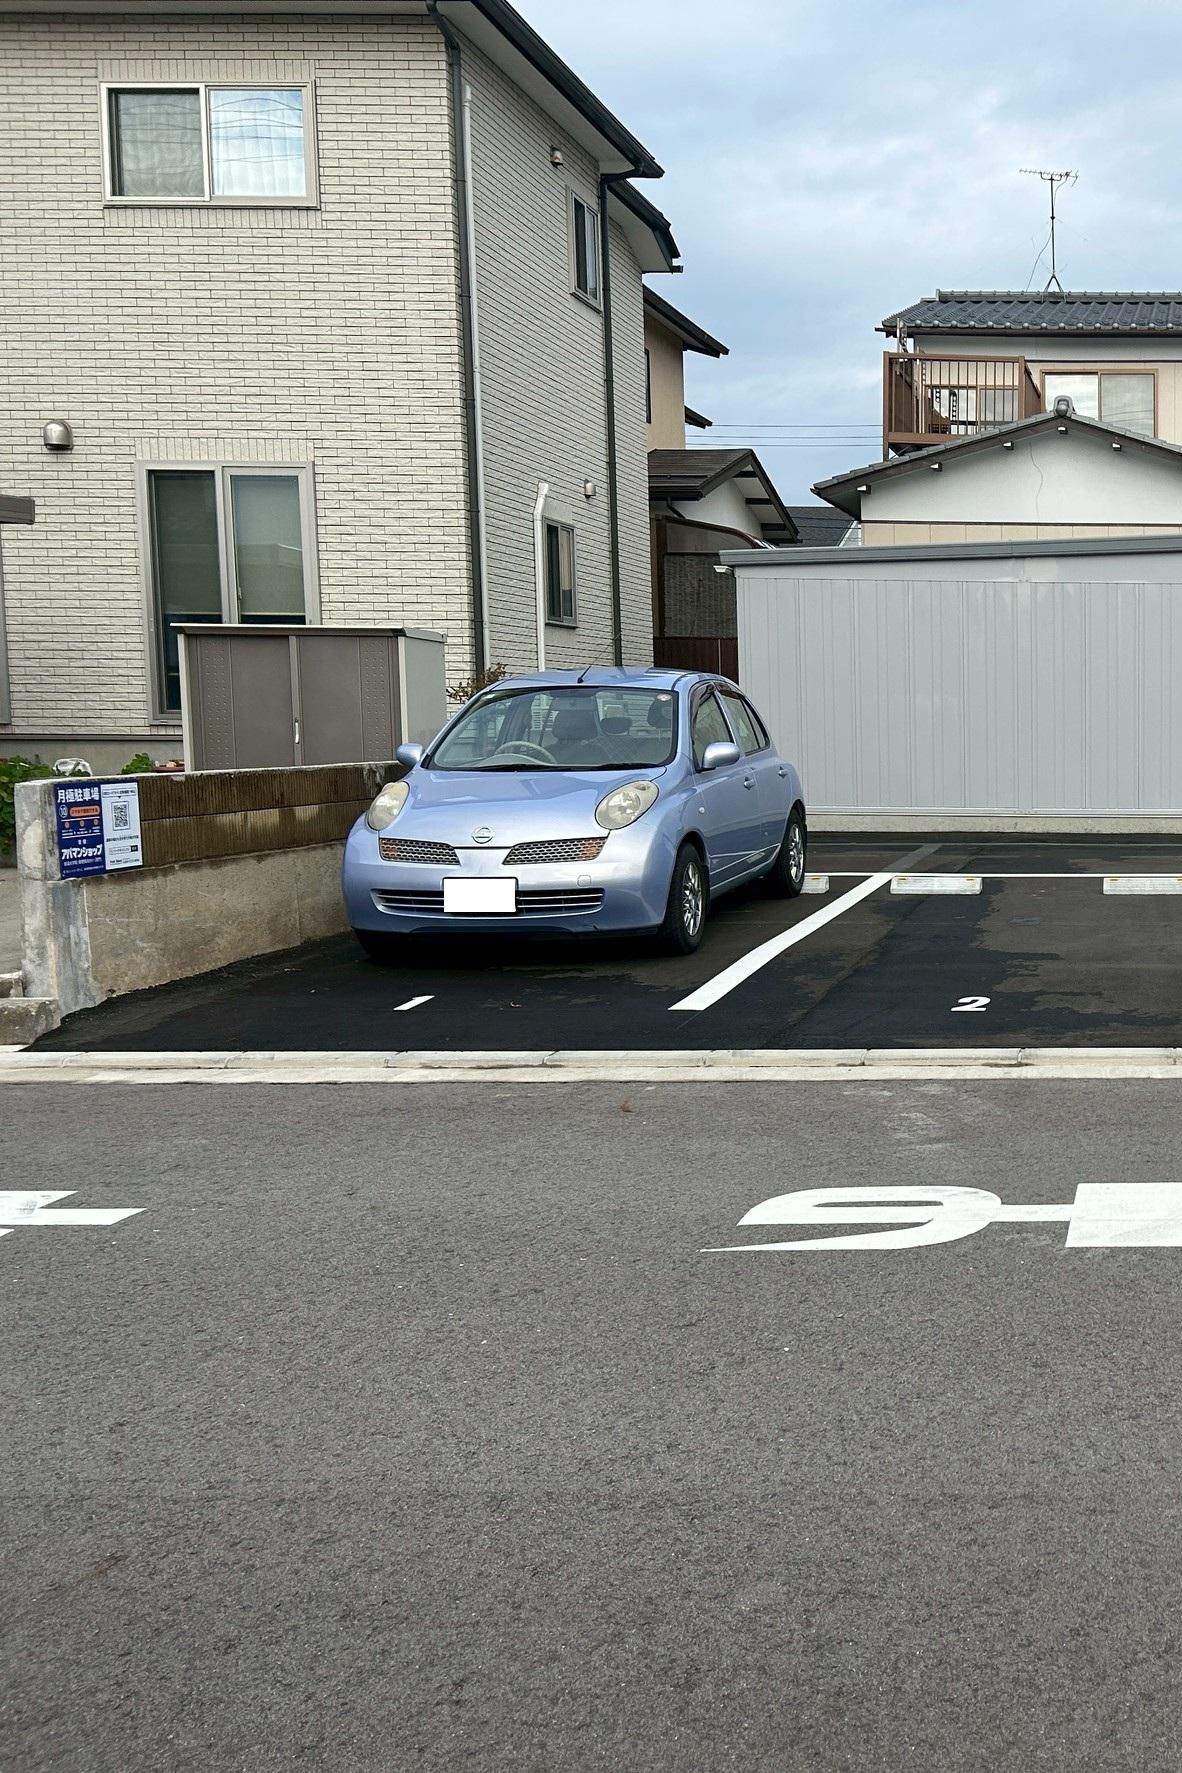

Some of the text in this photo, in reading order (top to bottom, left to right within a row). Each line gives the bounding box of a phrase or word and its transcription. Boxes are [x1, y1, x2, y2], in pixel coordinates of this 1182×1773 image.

[57, 786, 100, 803] 月極駐車場
[61, 843, 103, 860] アパマンショップ
[951, 996, 991, 1011] 2
